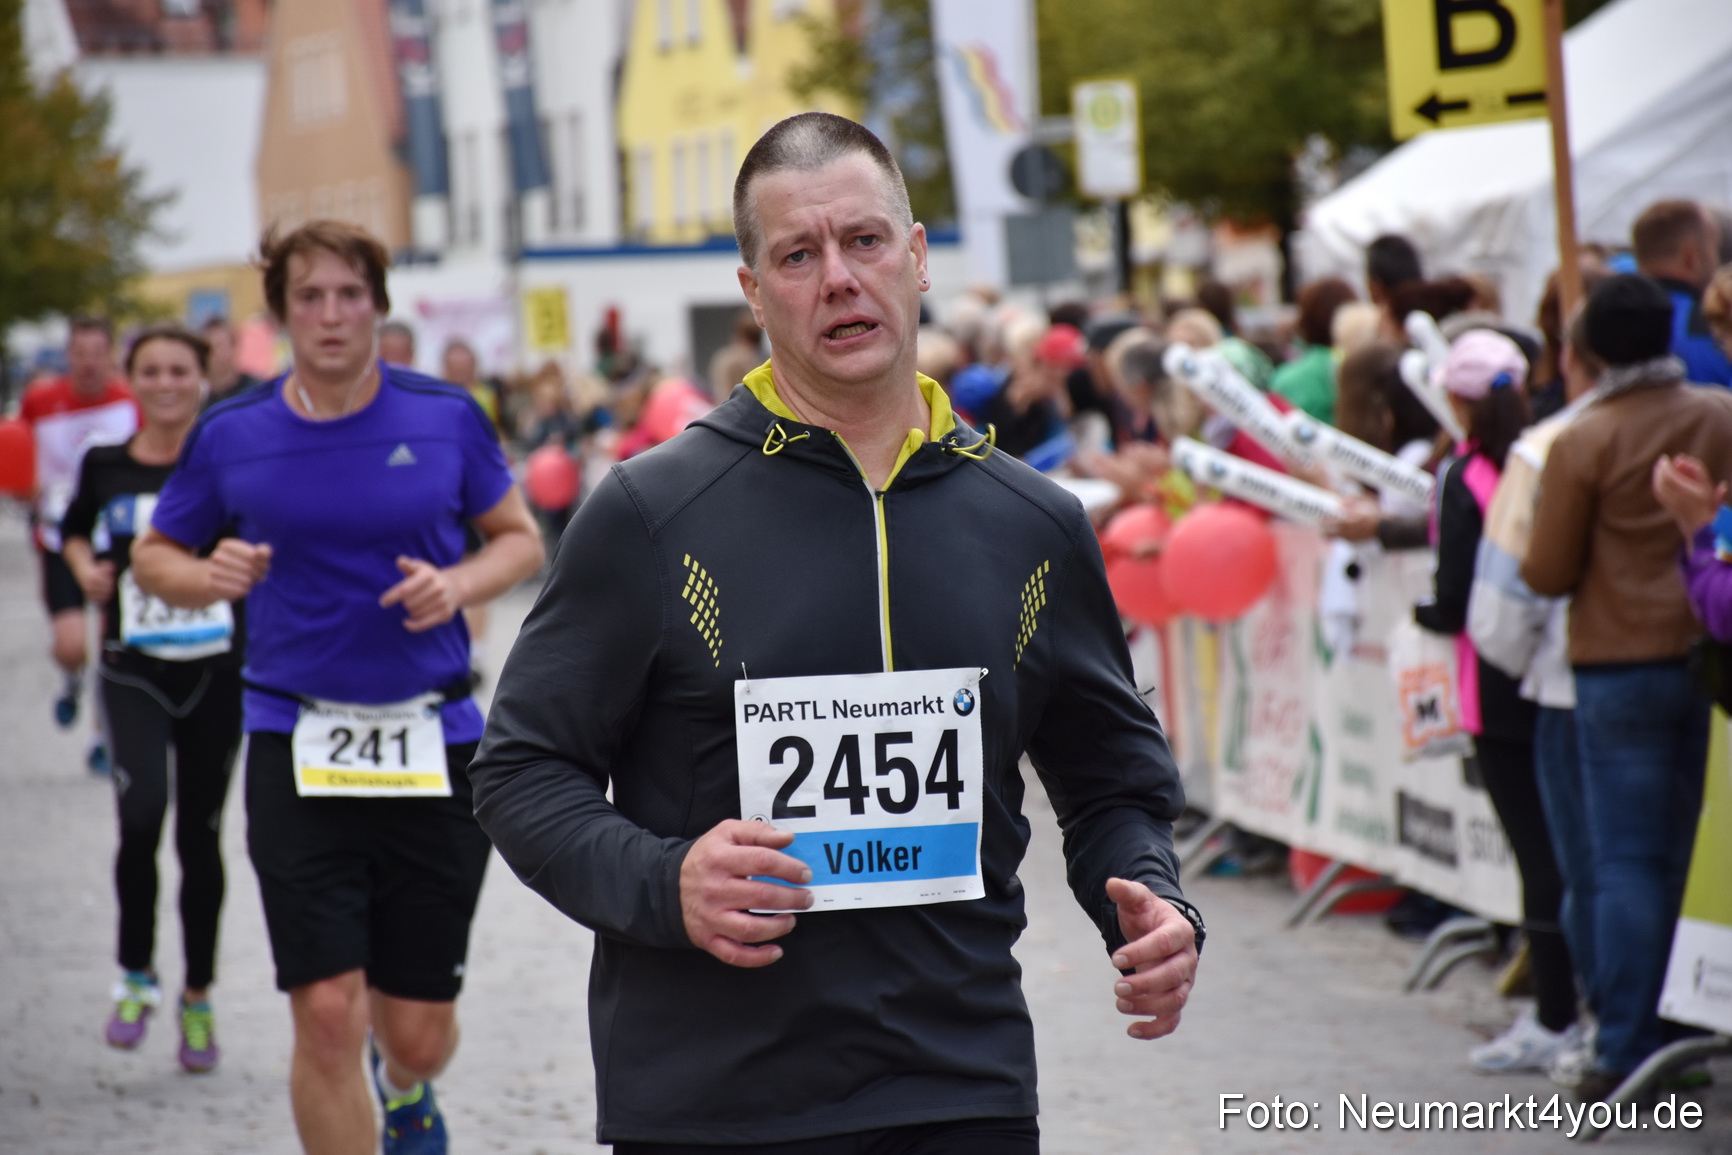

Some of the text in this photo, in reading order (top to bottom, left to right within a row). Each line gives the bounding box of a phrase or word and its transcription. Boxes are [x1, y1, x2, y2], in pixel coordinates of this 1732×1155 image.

[1434, 0, 1517, 72] B
[744, 695, 945, 723] PARTL Neumarkt
[328, 726, 409, 767] 241
[769, 728, 964, 820] 2454
[823, 840, 922, 875] Volker
